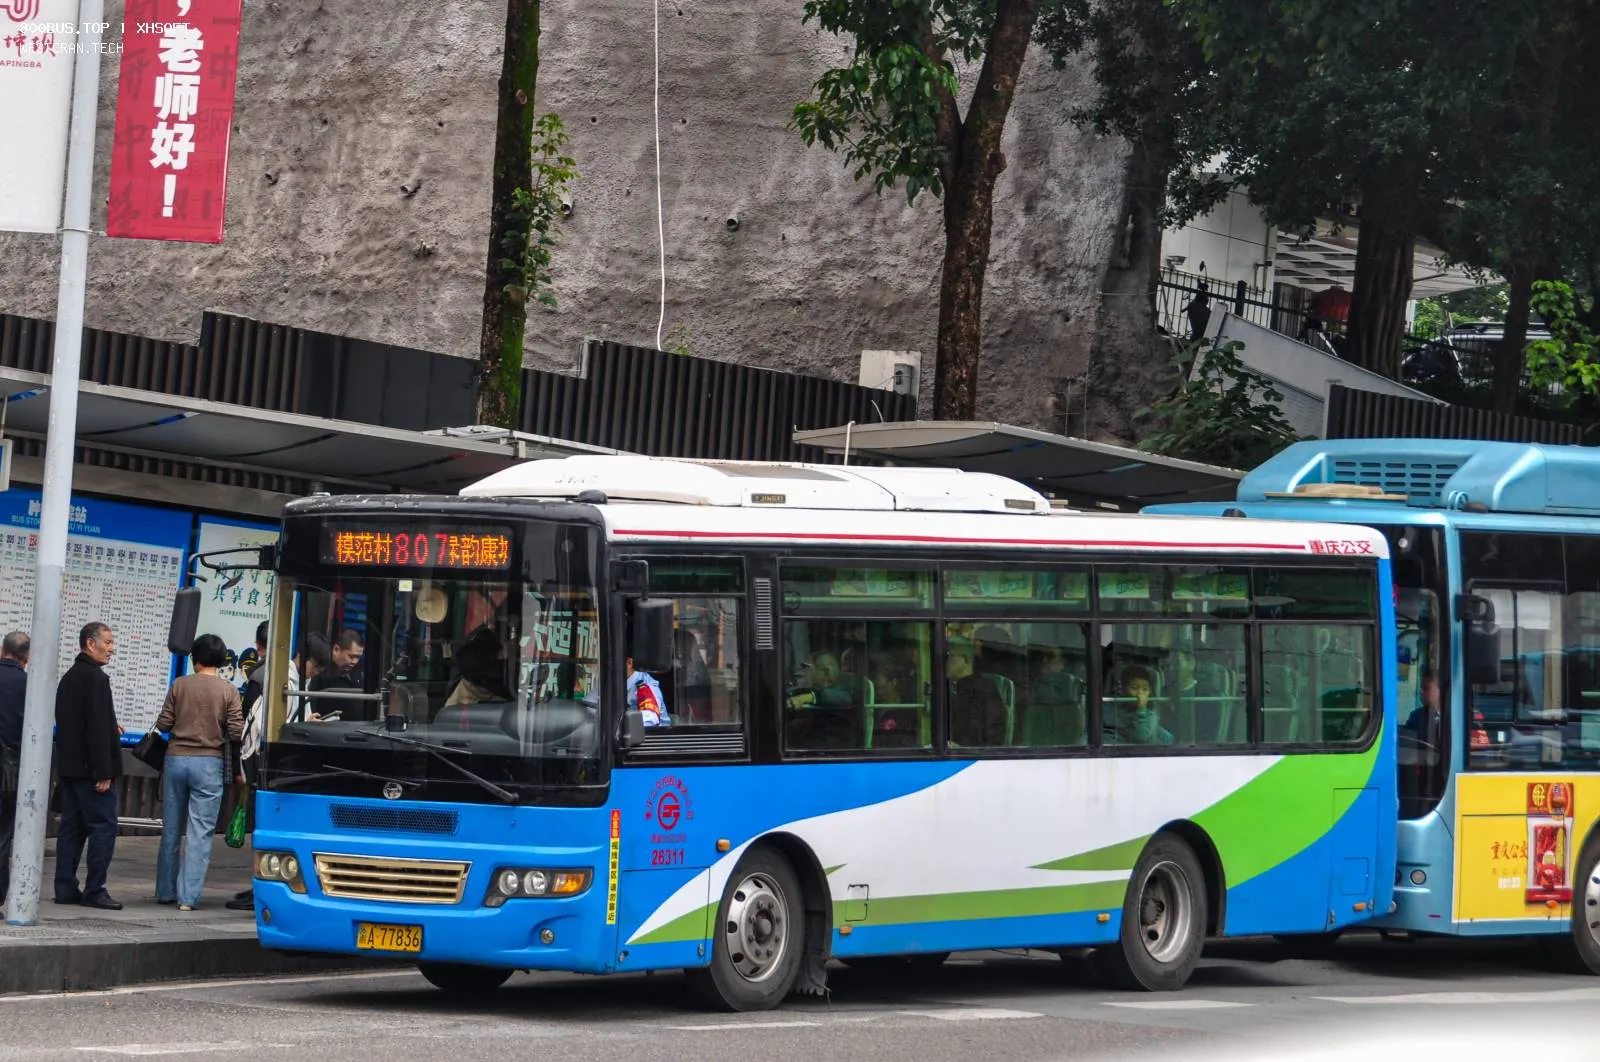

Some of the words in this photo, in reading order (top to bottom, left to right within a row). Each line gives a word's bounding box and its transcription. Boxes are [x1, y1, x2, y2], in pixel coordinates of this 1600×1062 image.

[337, 532, 392, 564] 模范村
[395, 533, 447, 565] 807
[1309, 540, 1373, 555] 重庆公交
[651, 849, 684, 865] 26311
